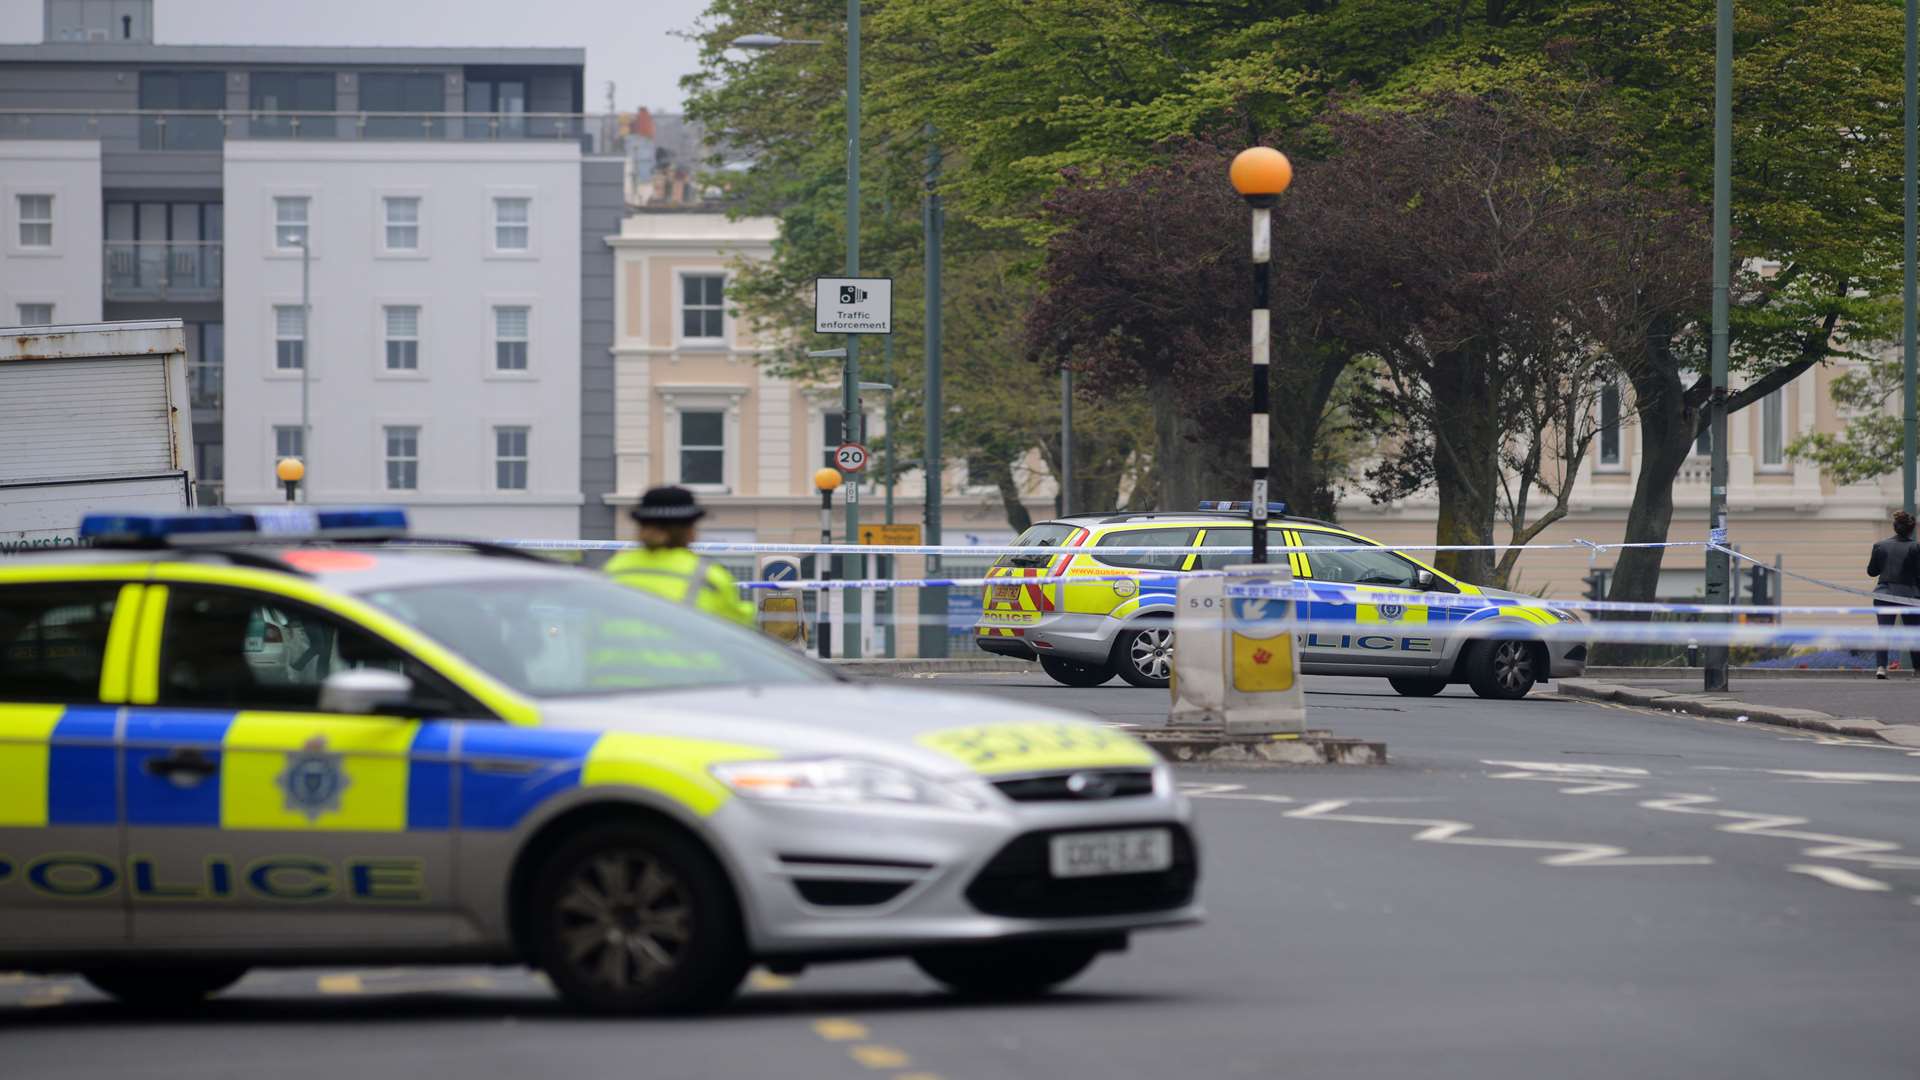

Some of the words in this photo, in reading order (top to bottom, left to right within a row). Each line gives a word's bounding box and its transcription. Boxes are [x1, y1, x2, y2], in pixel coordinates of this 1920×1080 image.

[837, 311, 871, 320] Traffic
[820, 321, 886, 329] enforcement
[840, 451, 863, 463] 20
[985, 613, 1032, 622] POLICE
[1297, 633, 1431, 652] LICE
